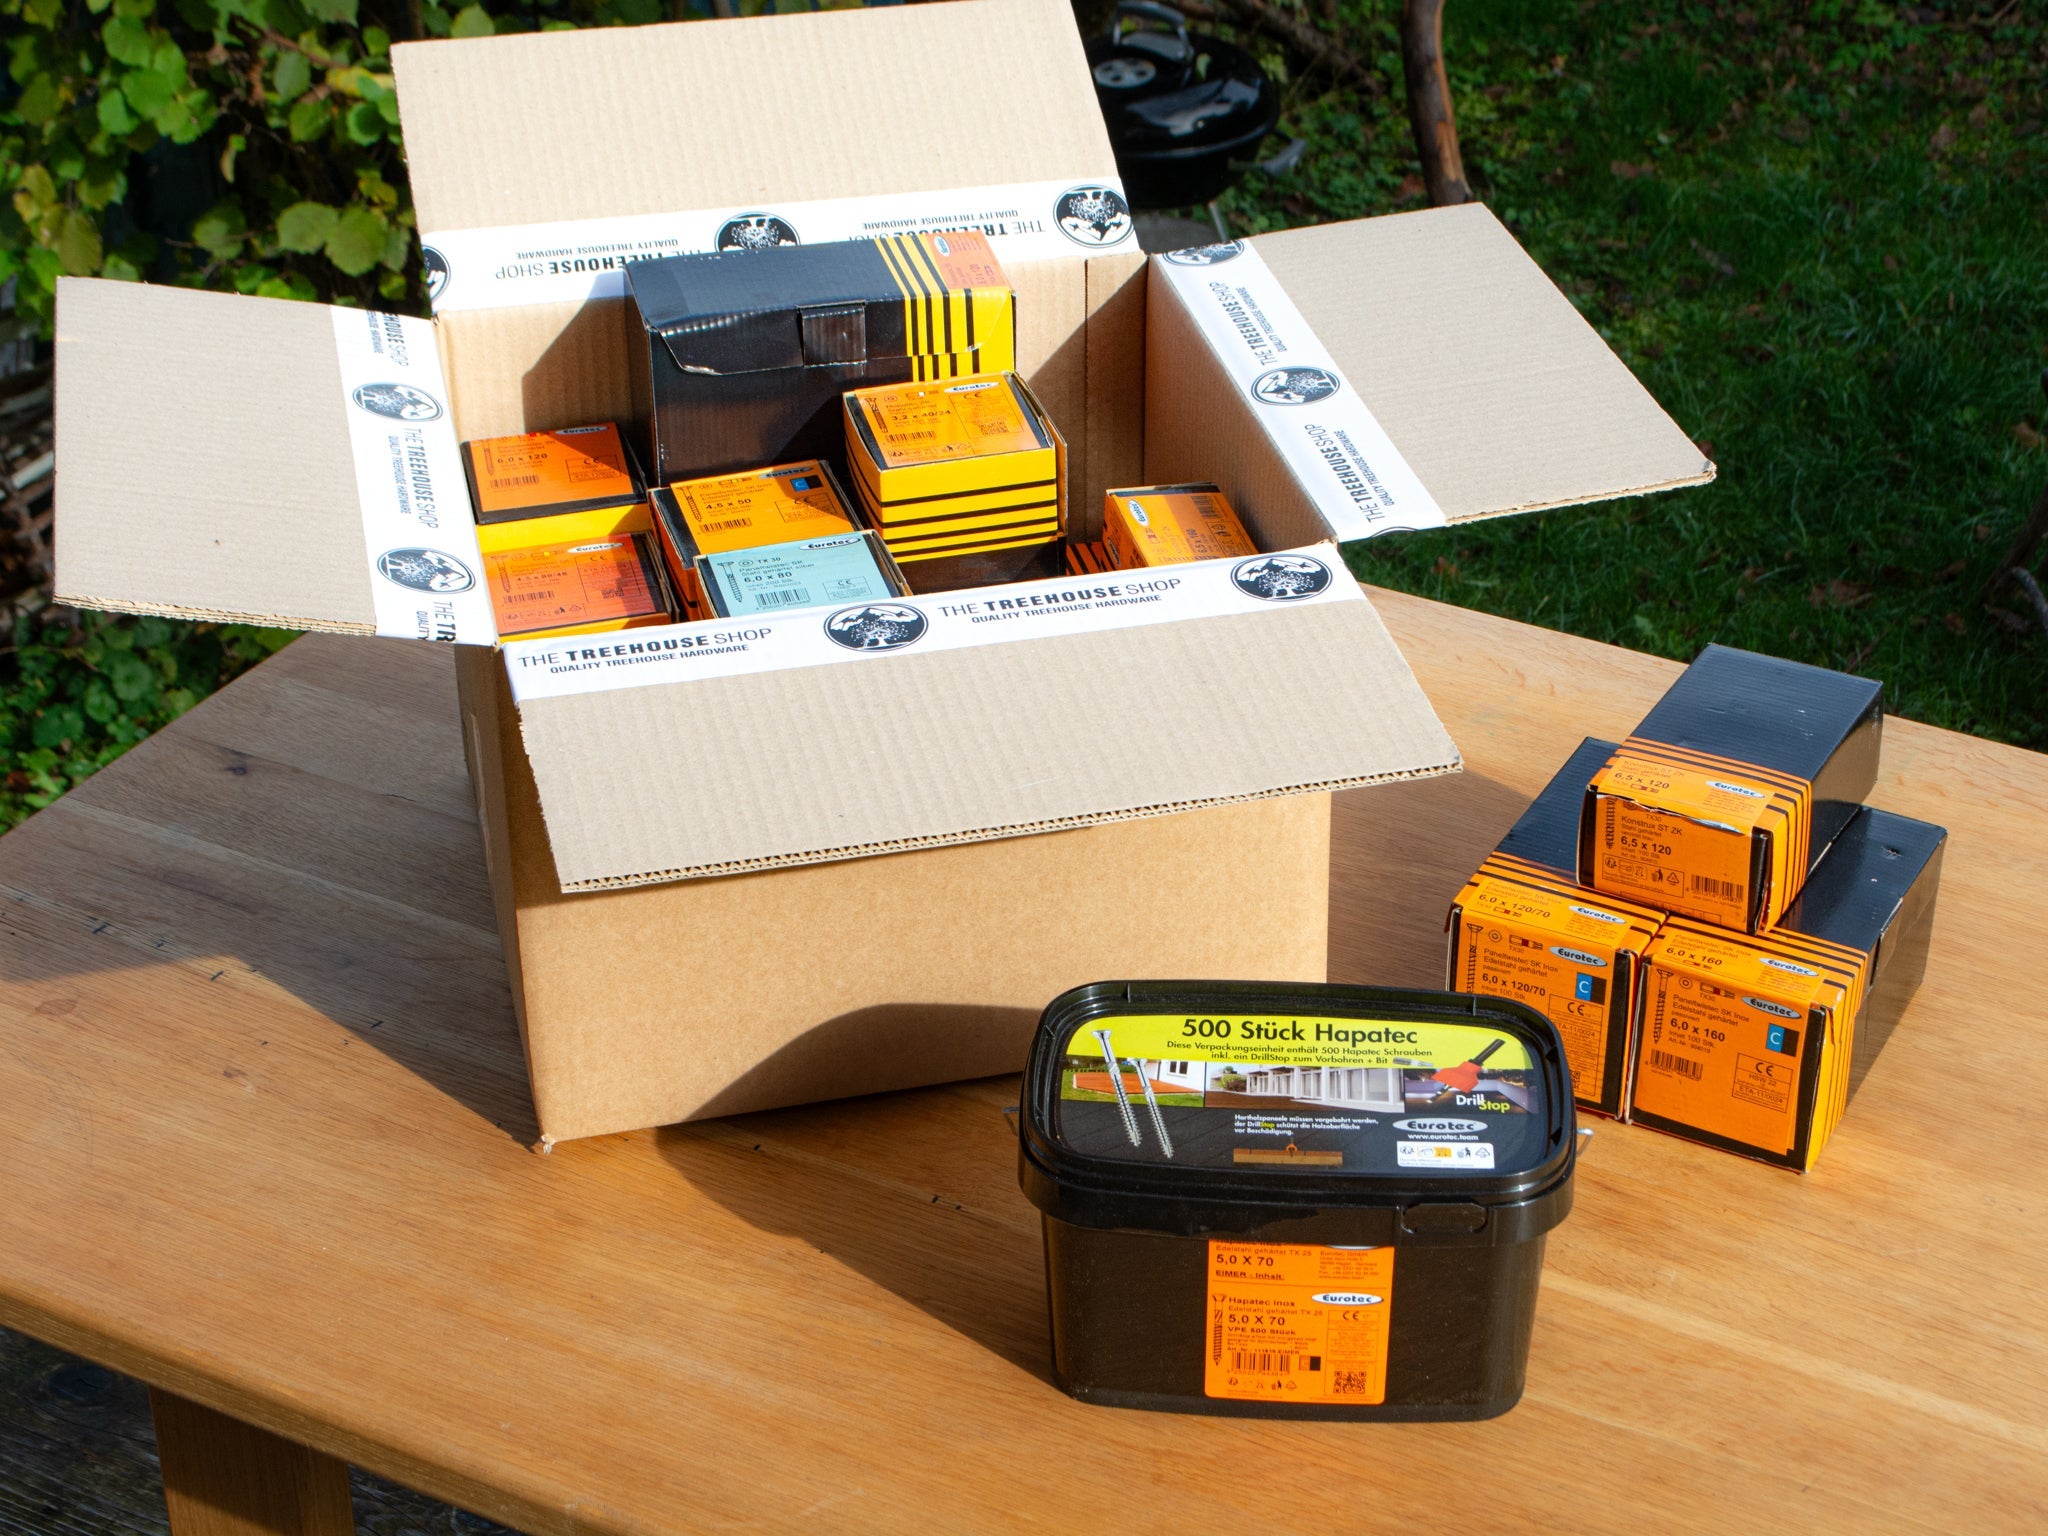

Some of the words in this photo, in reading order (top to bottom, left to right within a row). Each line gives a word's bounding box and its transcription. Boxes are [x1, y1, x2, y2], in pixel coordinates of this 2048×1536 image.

[920, 213, 974, 224] TREEHOUSE
[978, 209, 1018, 220] QUALITY
[862, 217, 917, 230] HARDWARE
[1013, 220, 1045, 234] THE
[576, 243, 633, 254] TREEHOUSE
[637, 238, 678, 249] QUALITY
[516, 248, 572, 259] HARDWARE
[496, 264, 544, 280] SHOP
[1209, 281, 1235, 301] SHOP
[1222, 301, 1267, 350] TREEHOUSE
[389, 344, 408, 366] SHOP
[1254, 350, 1278, 366] THE
[952, 384, 992, 392] Eurotec
[404, 428, 422, 444] THE
[1304, 424, 1334, 447] SHOP
[1334, 430, 1360, 457] HARDWARE
[388, 436, 402, 456] QUALITY
[392, 456, 407, 486] TREEHOUSE
[407, 445, 434, 503] TREEHOUSE
[766, 468, 804, 477] Eurotec
[1320, 446, 1372, 503] TREEHOUSE
[1352, 457, 1380, 485] TREEHOUSE
[397, 486, 412, 514] HARDWARE
[1372, 486, 1395, 506] QUALITY
[417, 502, 439, 529] SHOP
[1358, 502, 1385, 522] THE
[808, 539, 850, 548] Eurotec
[938, 602, 979, 618] THE
[984, 586, 1122, 612] TREEHOUSE
[1126, 578, 1182, 595] SHOP
[434, 601, 455, 622] THE
[972, 610, 1020, 624] QUALITY
[1025, 602, 1093, 617] TREEHOUSE
[1096, 594, 1162, 608] HARDWARE
[518, 652, 559, 668] THE
[566, 635, 710, 661] TREEHOUSE
[714, 628, 772, 645] SHOP
[550, 660, 602, 674] QUALITY
[606, 653, 676, 668] TREEHOUSE
[680, 644, 750, 659] HARDWARE
[1614, 772, 1632, 782] 6,5
[1649, 778, 1670, 789] 120
[1715, 782, 1756, 796] Eurotec
[1622, 815, 1656, 830] Konstrux
[1658, 824, 1670, 832] ST
[1671, 826, 1682, 836] ZK
[1646, 813, 1662, 822] TX30
[1620, 836, 1638, 848] 6,5
[1652, 844, 1672, 855] 120
[1479, 894, 1498, 904] 6,0
[1512, 902, 1551, 918] 120/70
[1577, 907, 1618, 922] Eurotec
[1510, 946, 1524, 954] TX30
[1558, 948, 1598, 965] Eurotec
[1666, 948, 1686, 958] 6,0
[1701, 955, 1722, 966] 160
[1484, 956, 1516, 969] Edelstahl
[1518, 964, 1548, 978] gehärtet
[1543, 963, 1558, 973] Inox
[1768, 959, 1810, 975] Eurotec
[1482, 973, 1498, 984] 6,0
[1512, 981, 1546, 997] 120/70
[1578, 980, 1590, 994] C
[1700, 992, 1716, 1002] TX30
[1672, 1002, 1706, 1016] Edelstahl
[1708, 1012, 1738, 1027] gehärtet
[1721, 1008, 1732, 1016] SK
[1734, 1012, 1750, 1022] Inox
[1750, 998, 1792, 1016] Eurotec
[1182, 1018, 1232, 1038] 500
[1241, 1020, 1306, 1041] Stück
[1315, 1023, 1418, 1047] Hapatec
[1670, 1018, 1688, 1031] 6,0
[1692, 1026, 1700, 1034] x
[1704, 1028, 1726, 1042] 160
[1688, 1034, 1700, 1044] 100
[1770, 1032, 1782, 1045] C
[1167, 1040, 1192, 1050] Diese
[1195, 1042, 1284, 1054] Verpackungseinheit
[1287, 1044, 1318, 1055] enthält
[1321, 1046, 1340, 1056] 500
[1342, 1046, 1381, 1058] Hapatec
[1384, 1048, 1432, 1058] Schrauben
[1211, 1051, 1231, 1060] inkl.
[1250, 1052, 1290, 1062] DrillStop
[1315, 1055, 1364, 1064] Vorbohren
[1376, 1056, 1388, 1064] Bit
[1768, 1080, 1777, 1088] 22
[1456, 1094, 1484, 1106] Drill
[1479, 1100, 1510, 1114] Stop
[1234, 1114, 1288, 1122] Hartholzpaneele
[1407, 1120, 1474, 1130] Eurotec
[1246, 1128, 1294, 1136] Beschädigung.
[1216, 1245, 1252, 1254] Edelstahl
[1216, 1254, 1238, 1266] 5,0
[1242, 1256, 1252, 1265] X
[1258, 1256, 1274, 1267] 70
[1216, 1270, 1247, 1278] EIMER
[1228, 1296, 1271, 1306] Hapatec
[1322, 1294, 1372, 1303] Eurotec
[1228, 1304, 1264, 1314] Edelstahl
[1228, 1315, 1250, 1326] 5,0
[1254, 1316, 1264, 1325] X
[1270, 1316, 1286, 1326] 70
[1270, 1328, 1296, 1336] Stück
